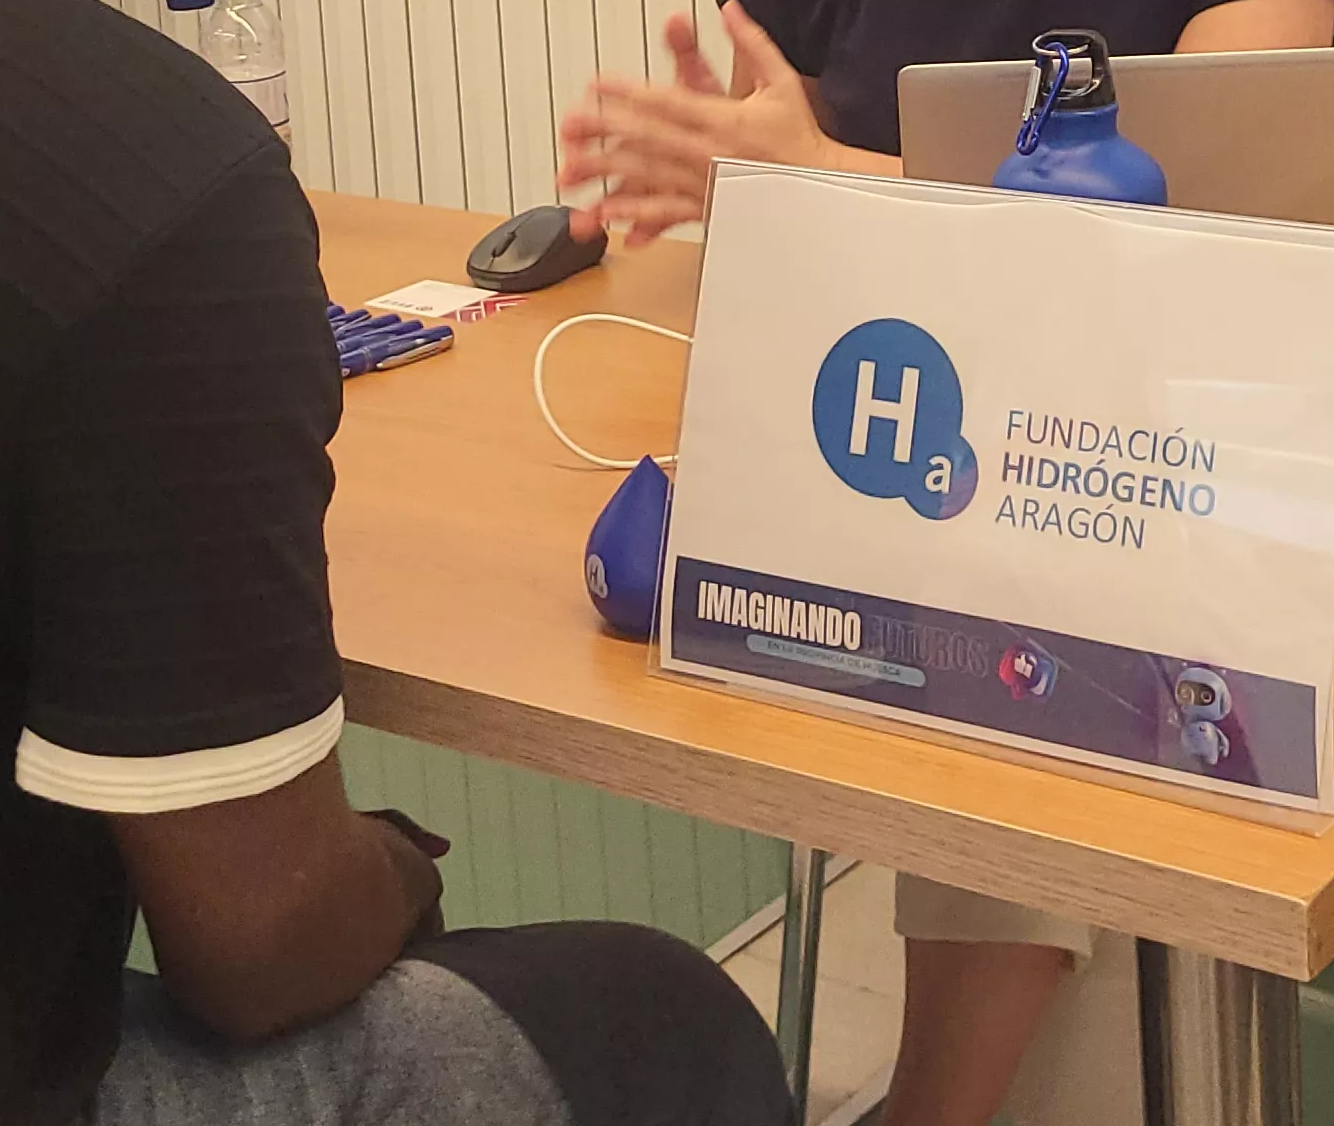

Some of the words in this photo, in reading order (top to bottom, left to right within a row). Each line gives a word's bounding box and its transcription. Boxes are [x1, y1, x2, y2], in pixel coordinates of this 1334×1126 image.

[1005, 409, 1215, 474] FUNDACIÓN
[1000, 450, 1216, 517] HIDRÓGENO
[995, 493, 1146, 550] ARAGÓN
[697, 580, 862, 651] IMAGINANDO
